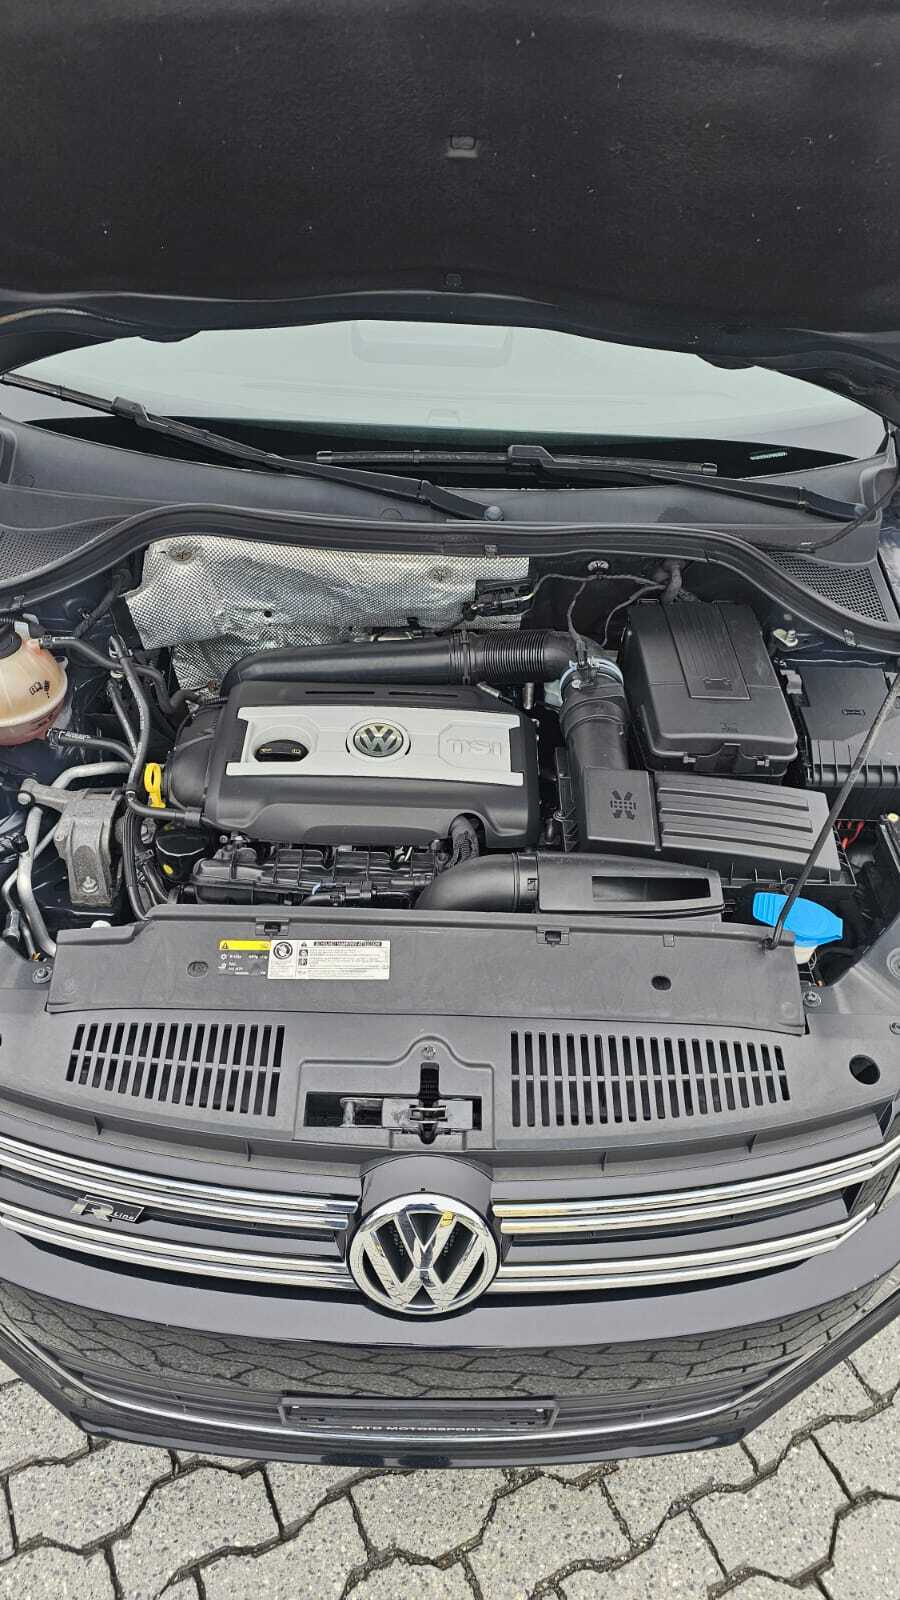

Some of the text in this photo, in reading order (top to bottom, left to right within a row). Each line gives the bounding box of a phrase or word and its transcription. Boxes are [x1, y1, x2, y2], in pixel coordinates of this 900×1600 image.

[354, 723, 403, 757] VW
[447, 738, 502, 760] TSI
[352, 1194, 495, 1314] VW
